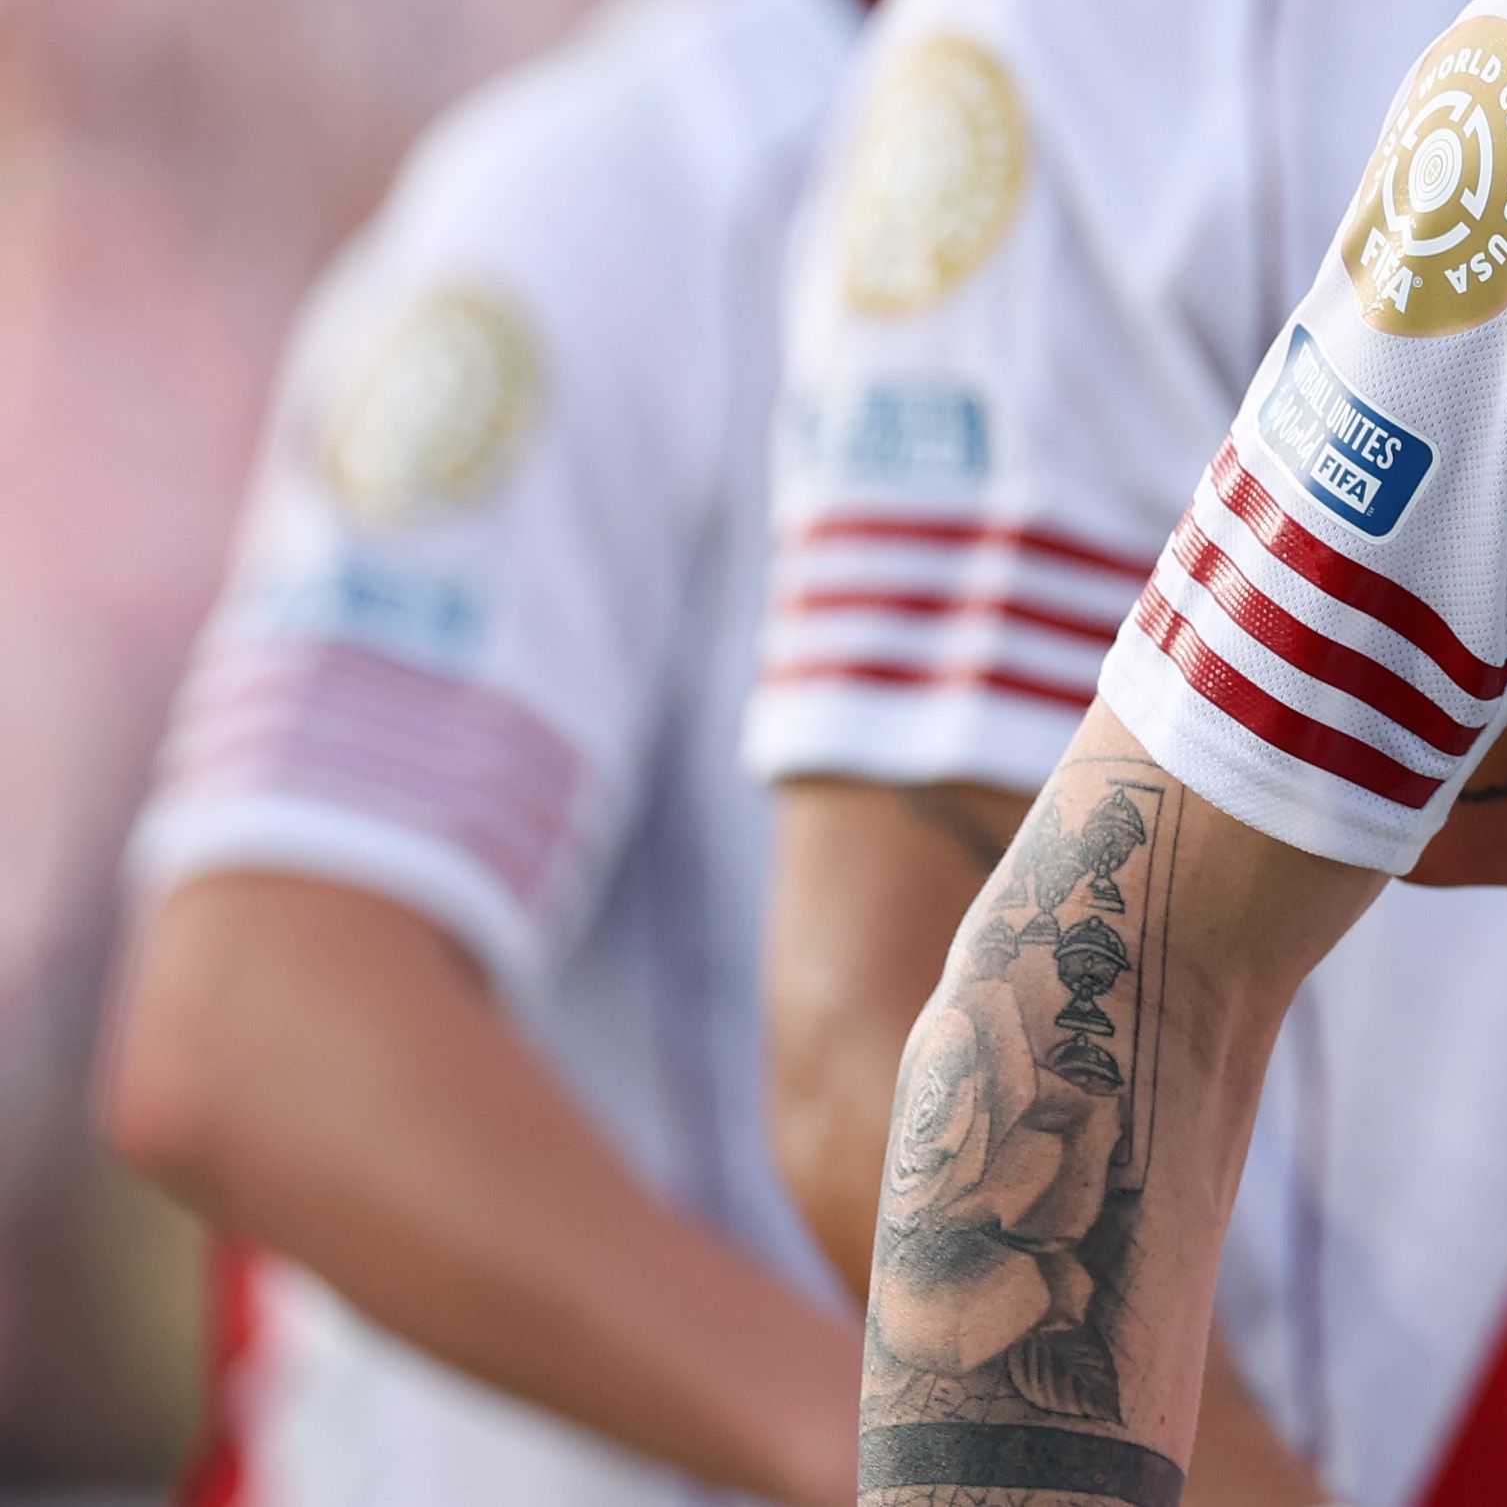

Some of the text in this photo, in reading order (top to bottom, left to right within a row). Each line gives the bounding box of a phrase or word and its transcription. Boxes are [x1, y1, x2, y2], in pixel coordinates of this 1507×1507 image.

[1419, 48, 1501, 99] WORLD
[1360, 227, 1414, 314] FIFA
[1326, 398, 1402, 470] UNITES
[1318, 453, 1371, 504] FIFA
